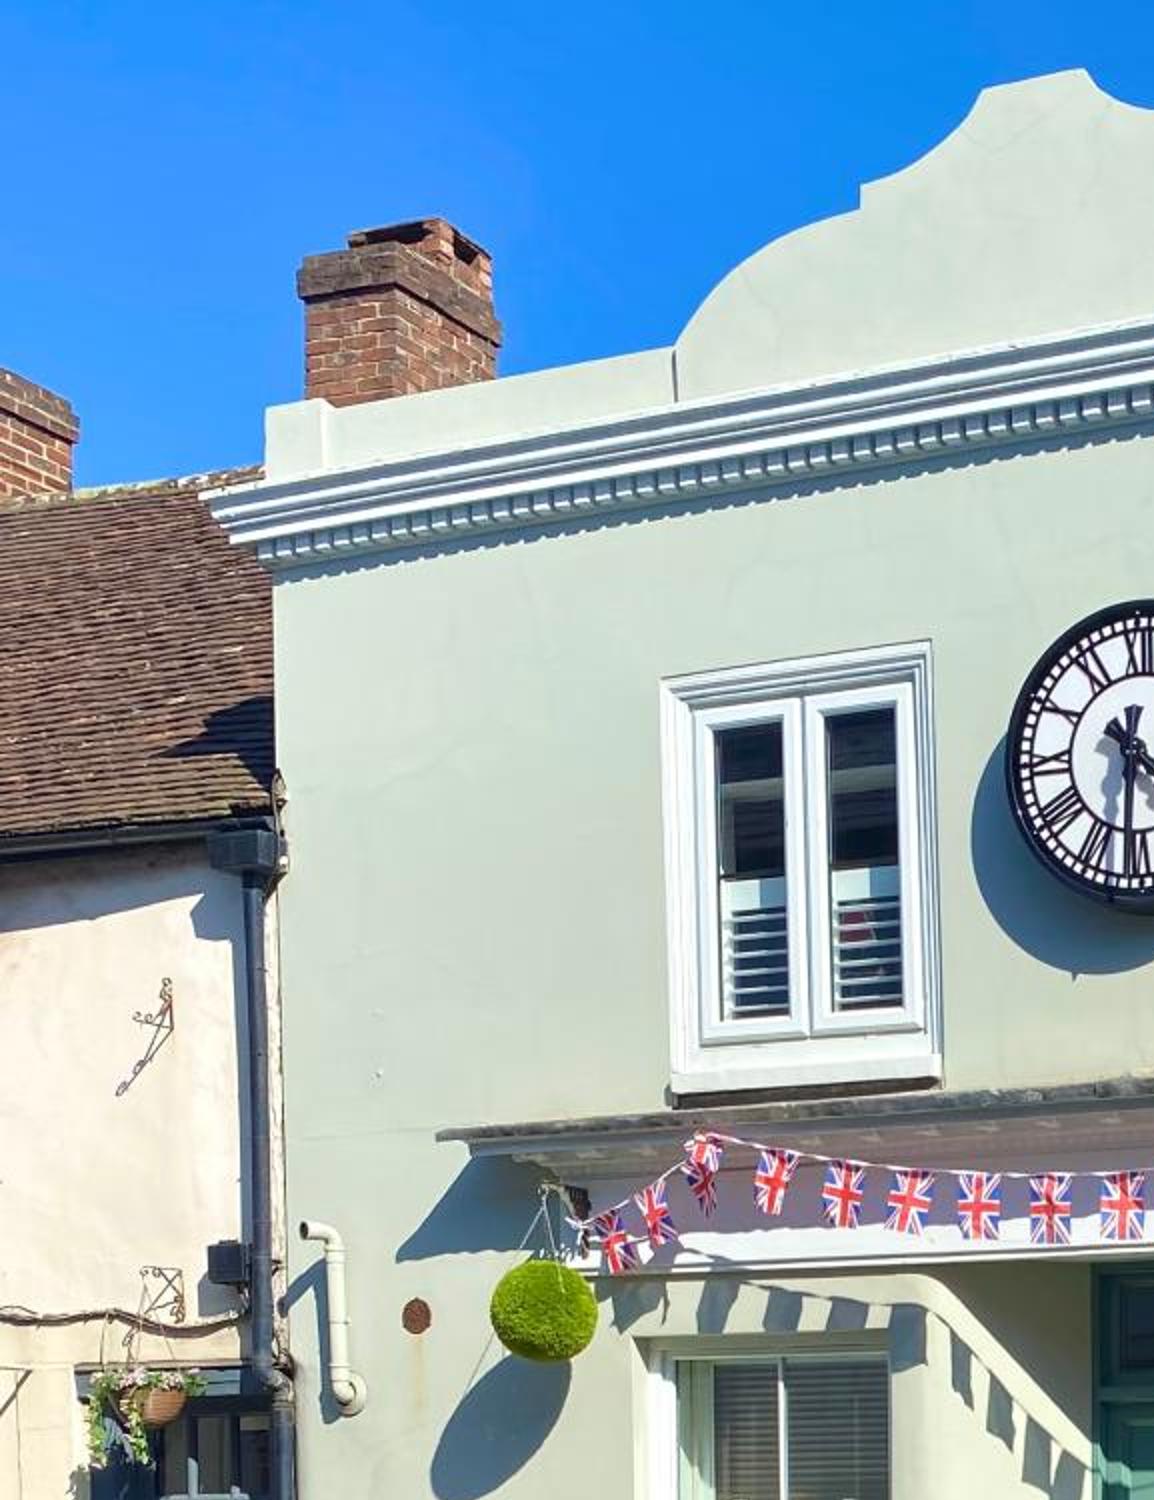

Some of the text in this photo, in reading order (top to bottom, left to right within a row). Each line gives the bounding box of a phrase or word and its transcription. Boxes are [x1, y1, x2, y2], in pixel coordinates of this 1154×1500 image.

[1123, 629, 1154, 673] XII
[1073, 646, 1112, 695] XI
[1043, 698, 1081, 726] X
[1032, 749, 1072, 777] IX
